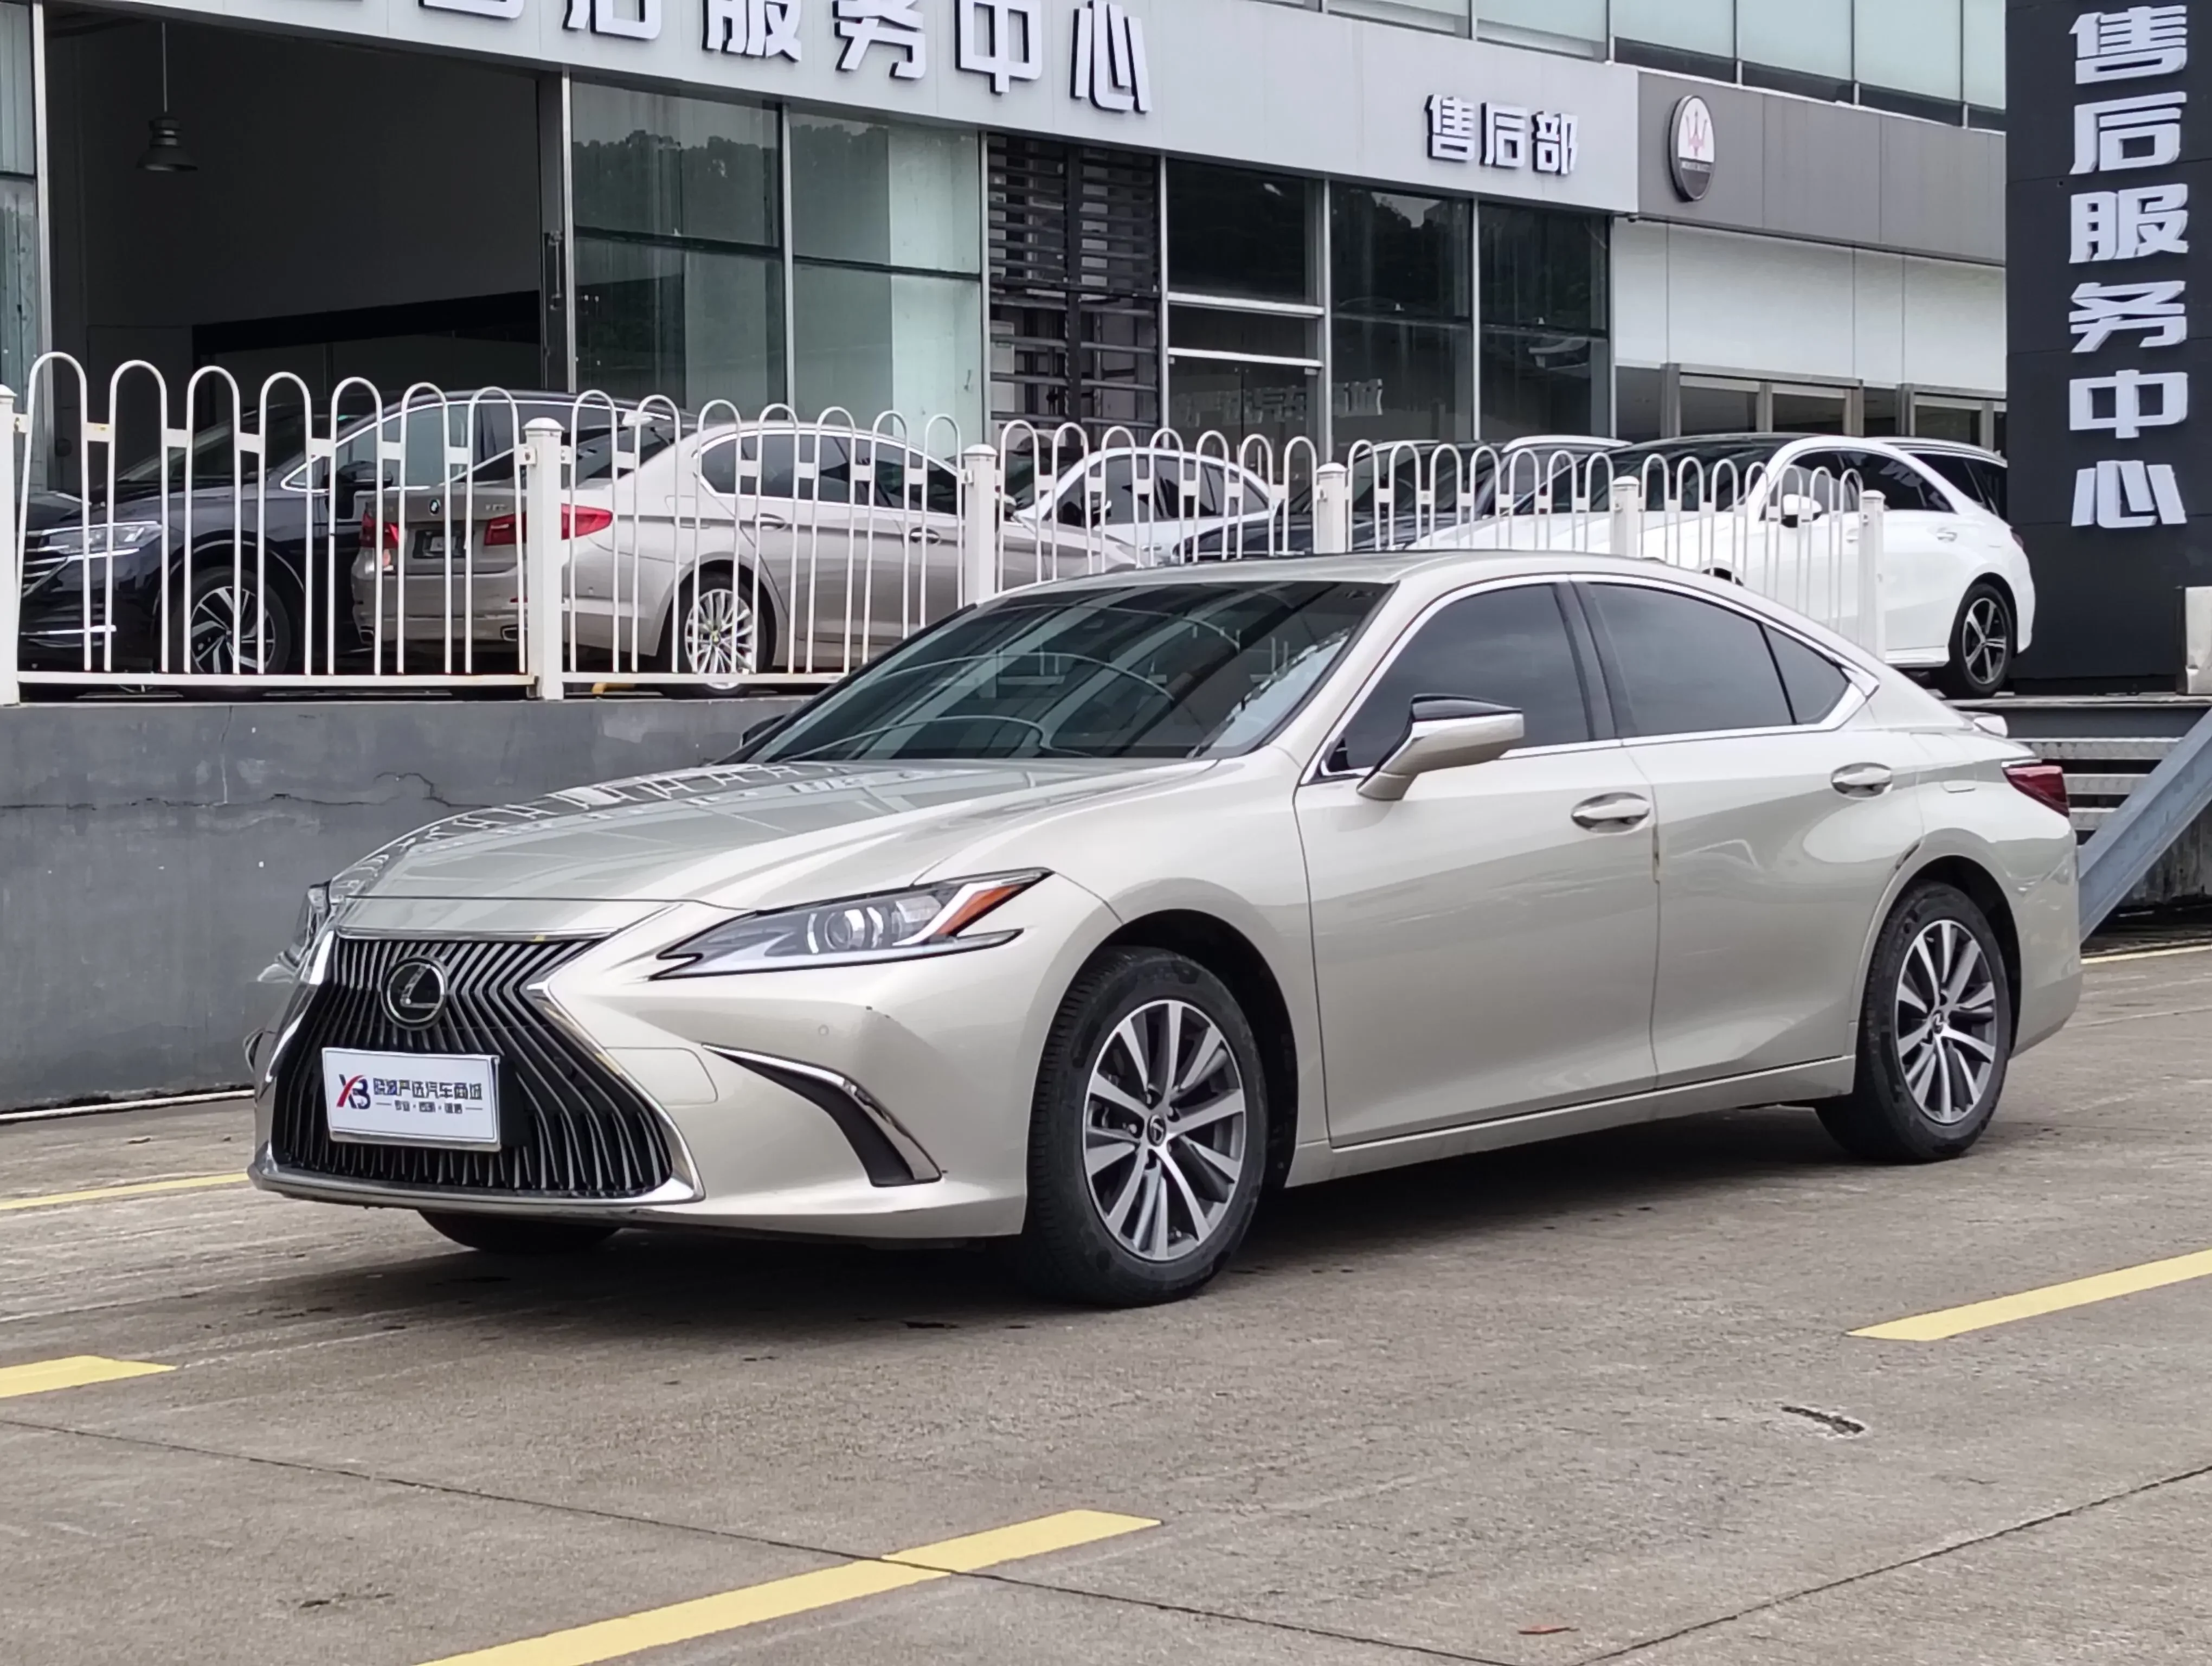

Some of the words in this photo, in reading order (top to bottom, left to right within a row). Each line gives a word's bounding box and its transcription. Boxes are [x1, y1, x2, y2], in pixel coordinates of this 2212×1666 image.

[419, 0, 1152, 114] 服务中心
[1425, 94, 1578, 175] 售后部
[2069, 5, 2188, 529] 售后服务中心
